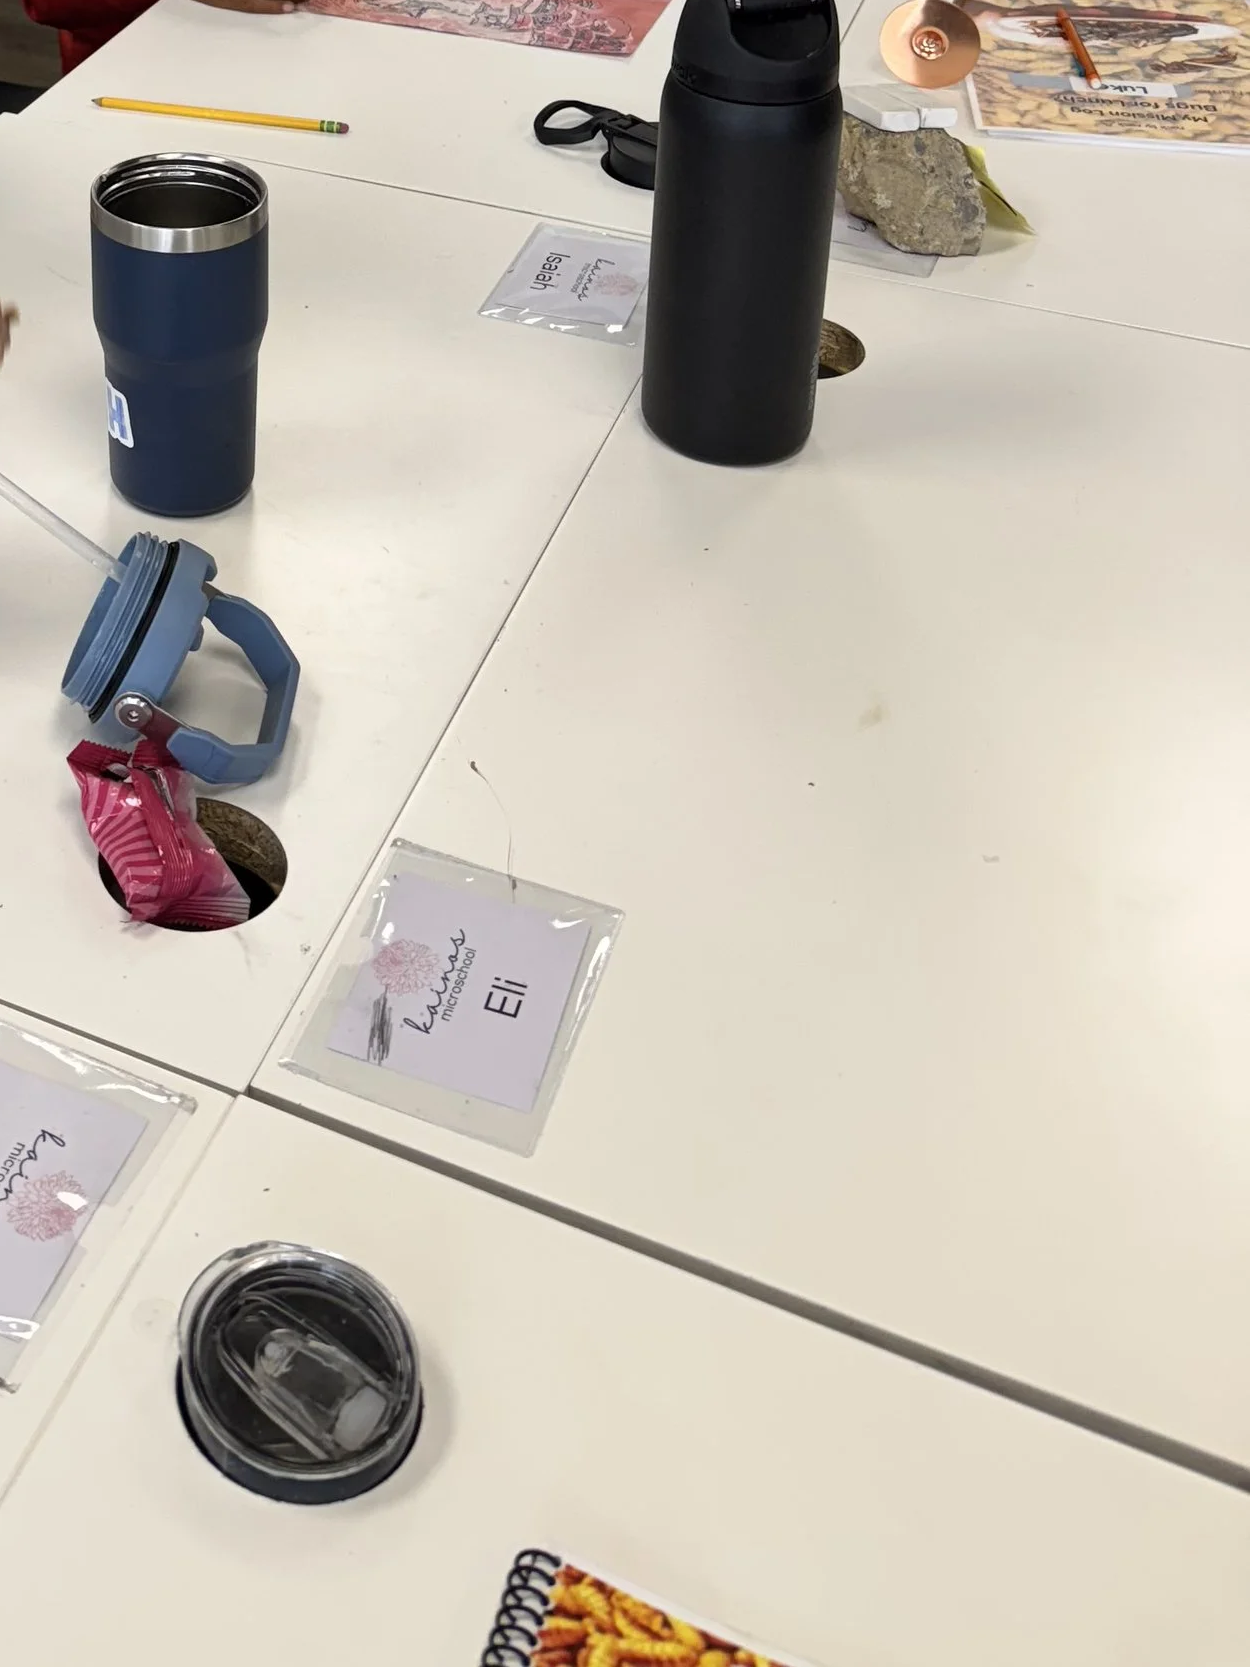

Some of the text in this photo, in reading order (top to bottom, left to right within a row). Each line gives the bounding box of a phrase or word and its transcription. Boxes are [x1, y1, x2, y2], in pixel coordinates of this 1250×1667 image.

[530, 251, 571, 291] Isaiah
[440, 946, 478, 1023] microschool
[483, 976, 528, 1020] Eli
